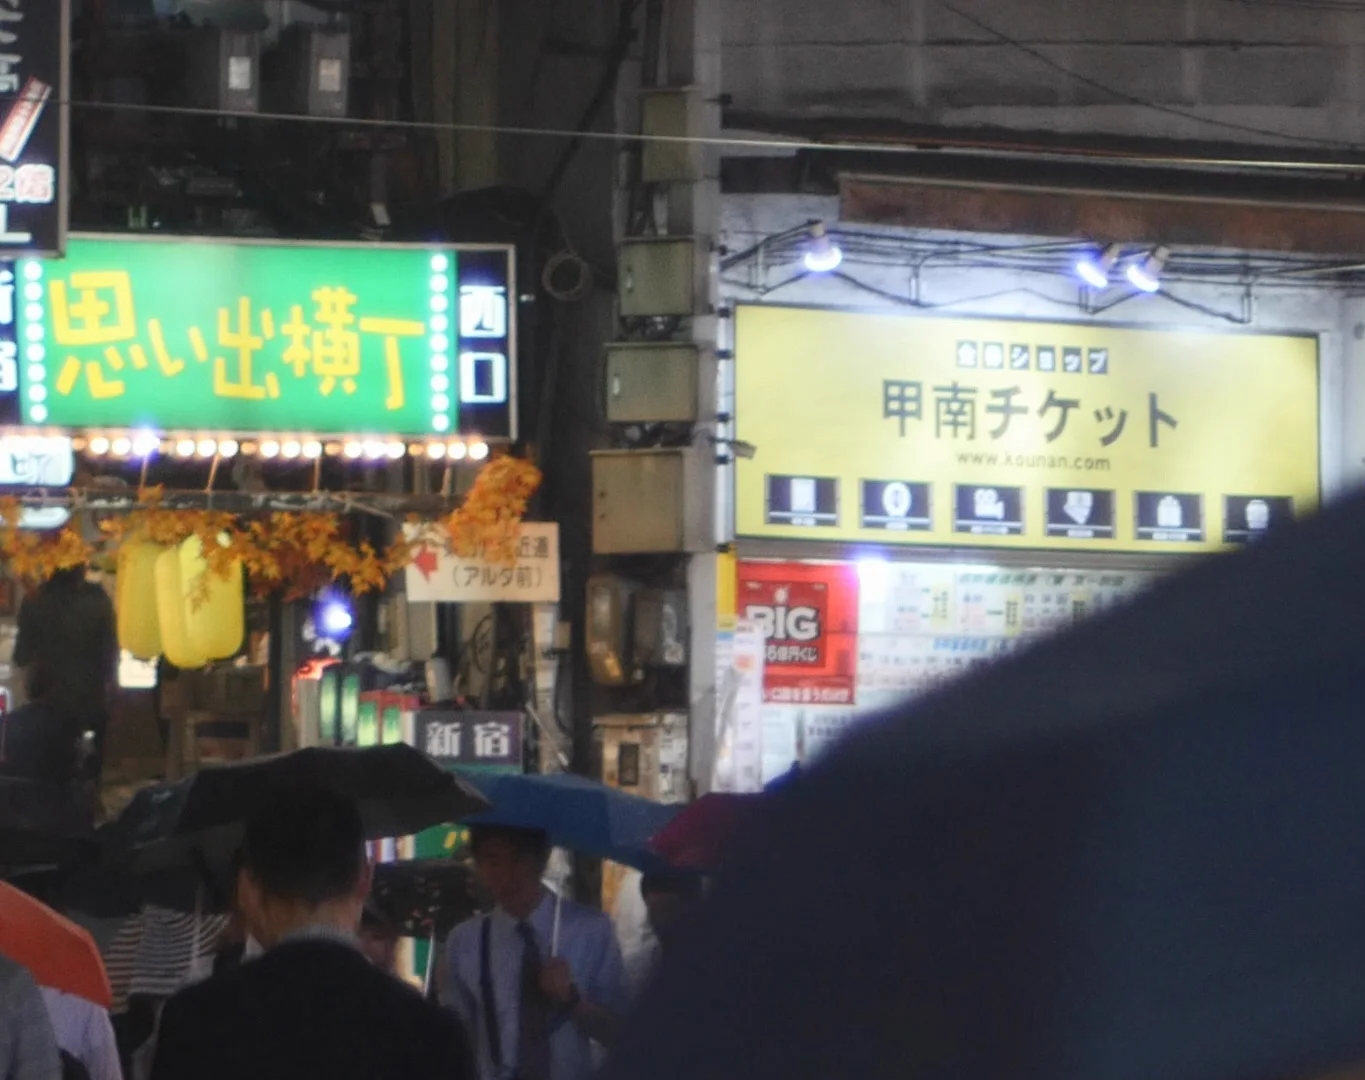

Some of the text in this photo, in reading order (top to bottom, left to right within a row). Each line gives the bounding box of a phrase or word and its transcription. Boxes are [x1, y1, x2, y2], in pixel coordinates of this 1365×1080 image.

[49, 270, 425, 409] 思い出横丁
[459, 285, 506, 403] 西口
[882, 378, 1178, 448] 甲南チケット
[955, 449, 1111, 471] www.kounan.com
[745, 604, 820, 643] BIG
[427, 721, 511, 758] 新宿
